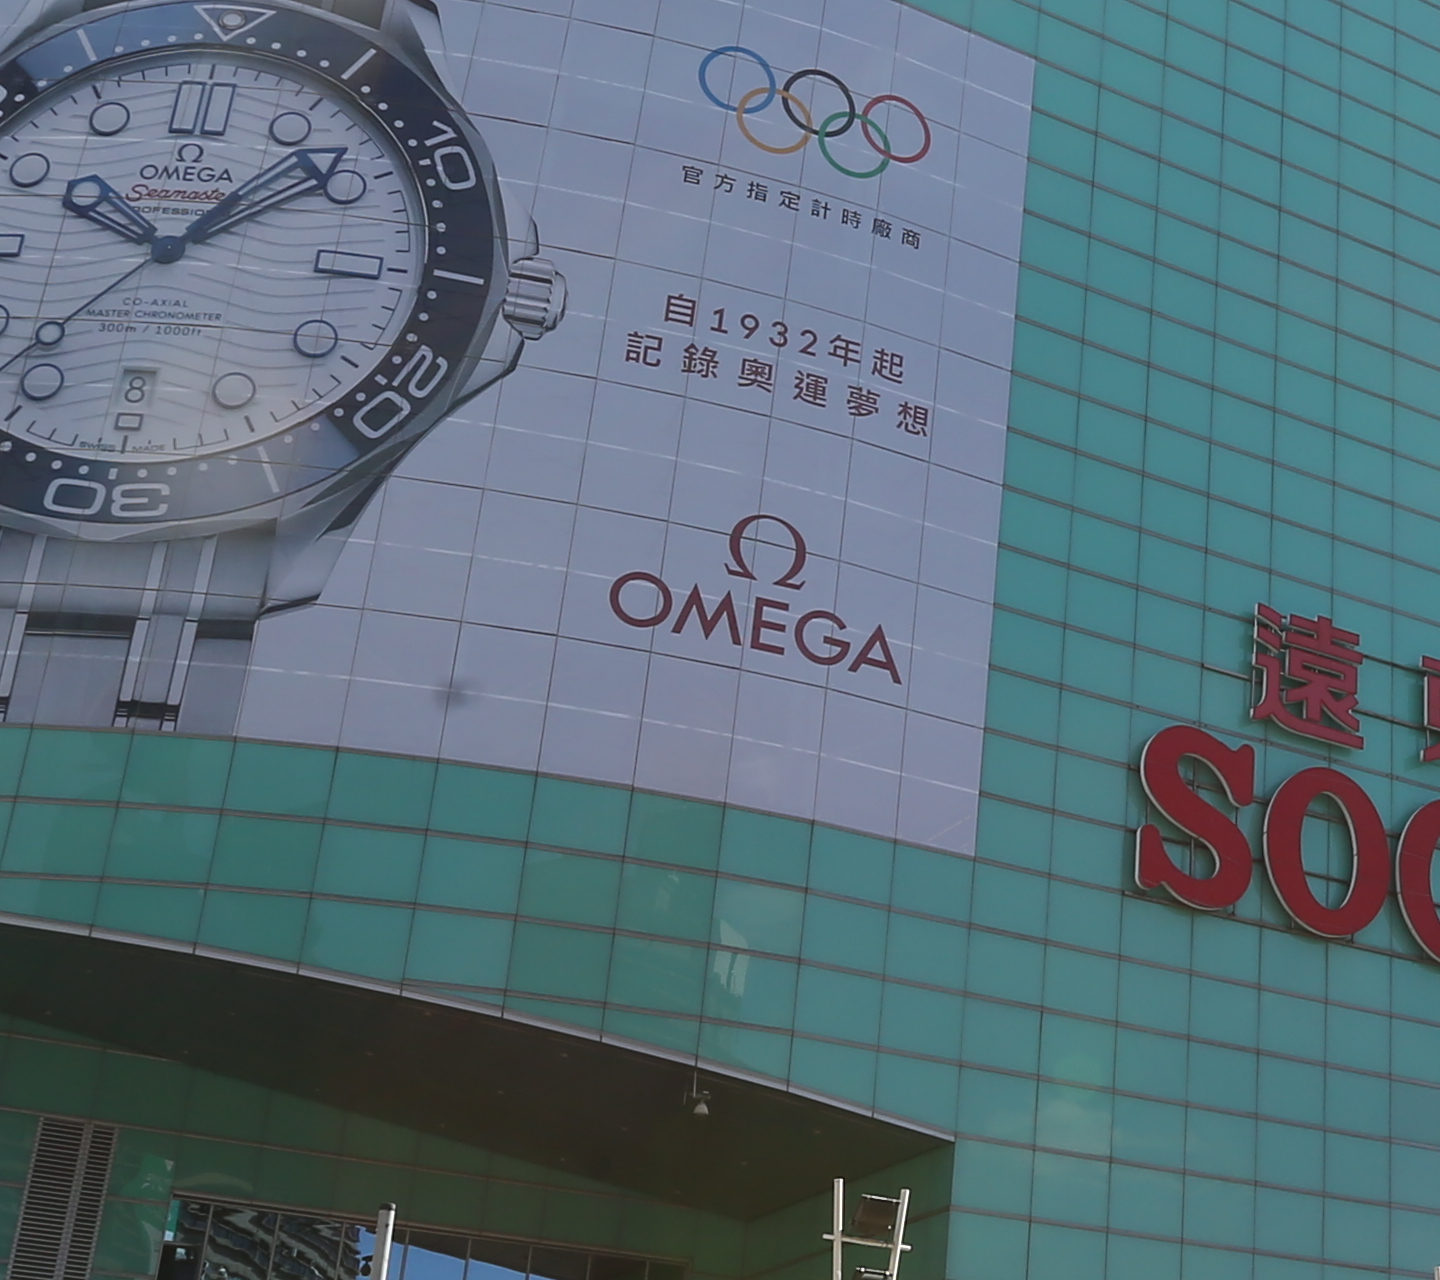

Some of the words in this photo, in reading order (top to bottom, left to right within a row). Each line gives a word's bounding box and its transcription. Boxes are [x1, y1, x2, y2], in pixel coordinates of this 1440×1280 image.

[139, 163, 234, 184] OMEGA
[427, 118, 479, 194] 10
[125, 183, 227, 202] Seamaste
[681, 164, 922, 250] 官方指定計時廠商
[84, 307, 131, 320] MASTER
[134, 308, 223, 322] CHRONOMETER
[122, 297, 190, 308] CO-AXIAL
[97, 323, 138, 334] 300m
[154, 324, 202, 337] 1000ft
[663, 292, 905, 384] 自1932年起
[126, 377, 146, 404] 8
[353, 345, 449, 440] 20
[625, 330, 930, 438] 記錄奧運夢想
[42, 476, 171, 519] 30
[609, 570, 903, 685] OMEGA
